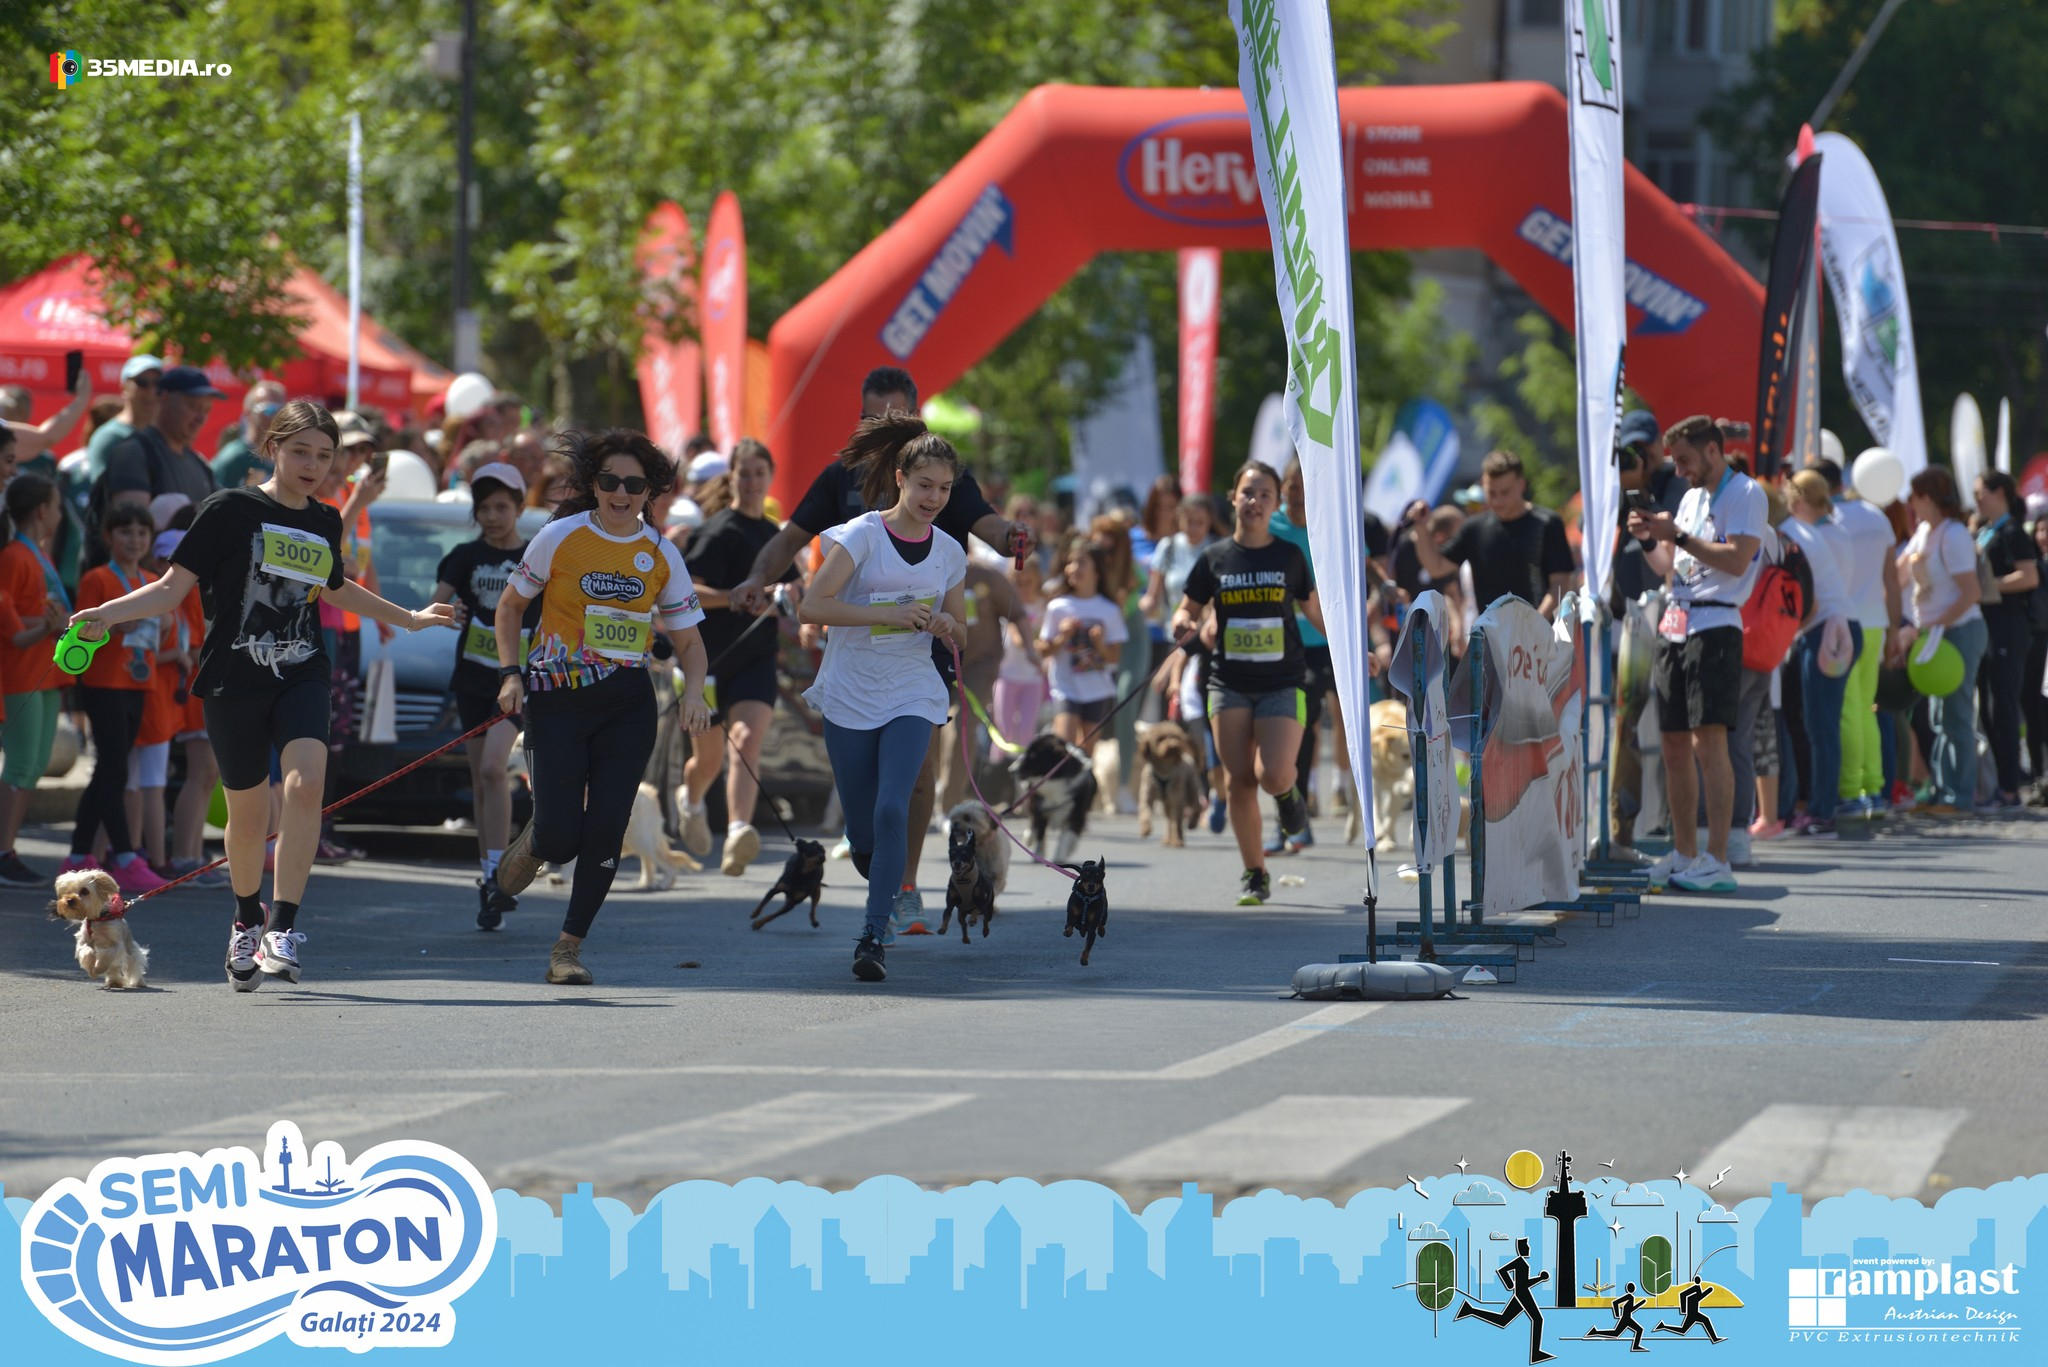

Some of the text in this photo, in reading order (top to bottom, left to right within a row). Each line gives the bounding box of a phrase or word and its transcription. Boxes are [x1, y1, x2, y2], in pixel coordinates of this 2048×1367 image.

[1142, 138, 1259, 205] Herv
[881, 289, 936, 358] GET
[274, 540, 323, 566] 3007
[478, 577, 507, 590] PUM
[592, 572, 613, 581] SEMI
[592, 580, 639, 593] MARATON
[594, 623, 637, 643] 3009
[1232, 633, 1274, 647] 3014
[474, 634, 497, 652] 30
